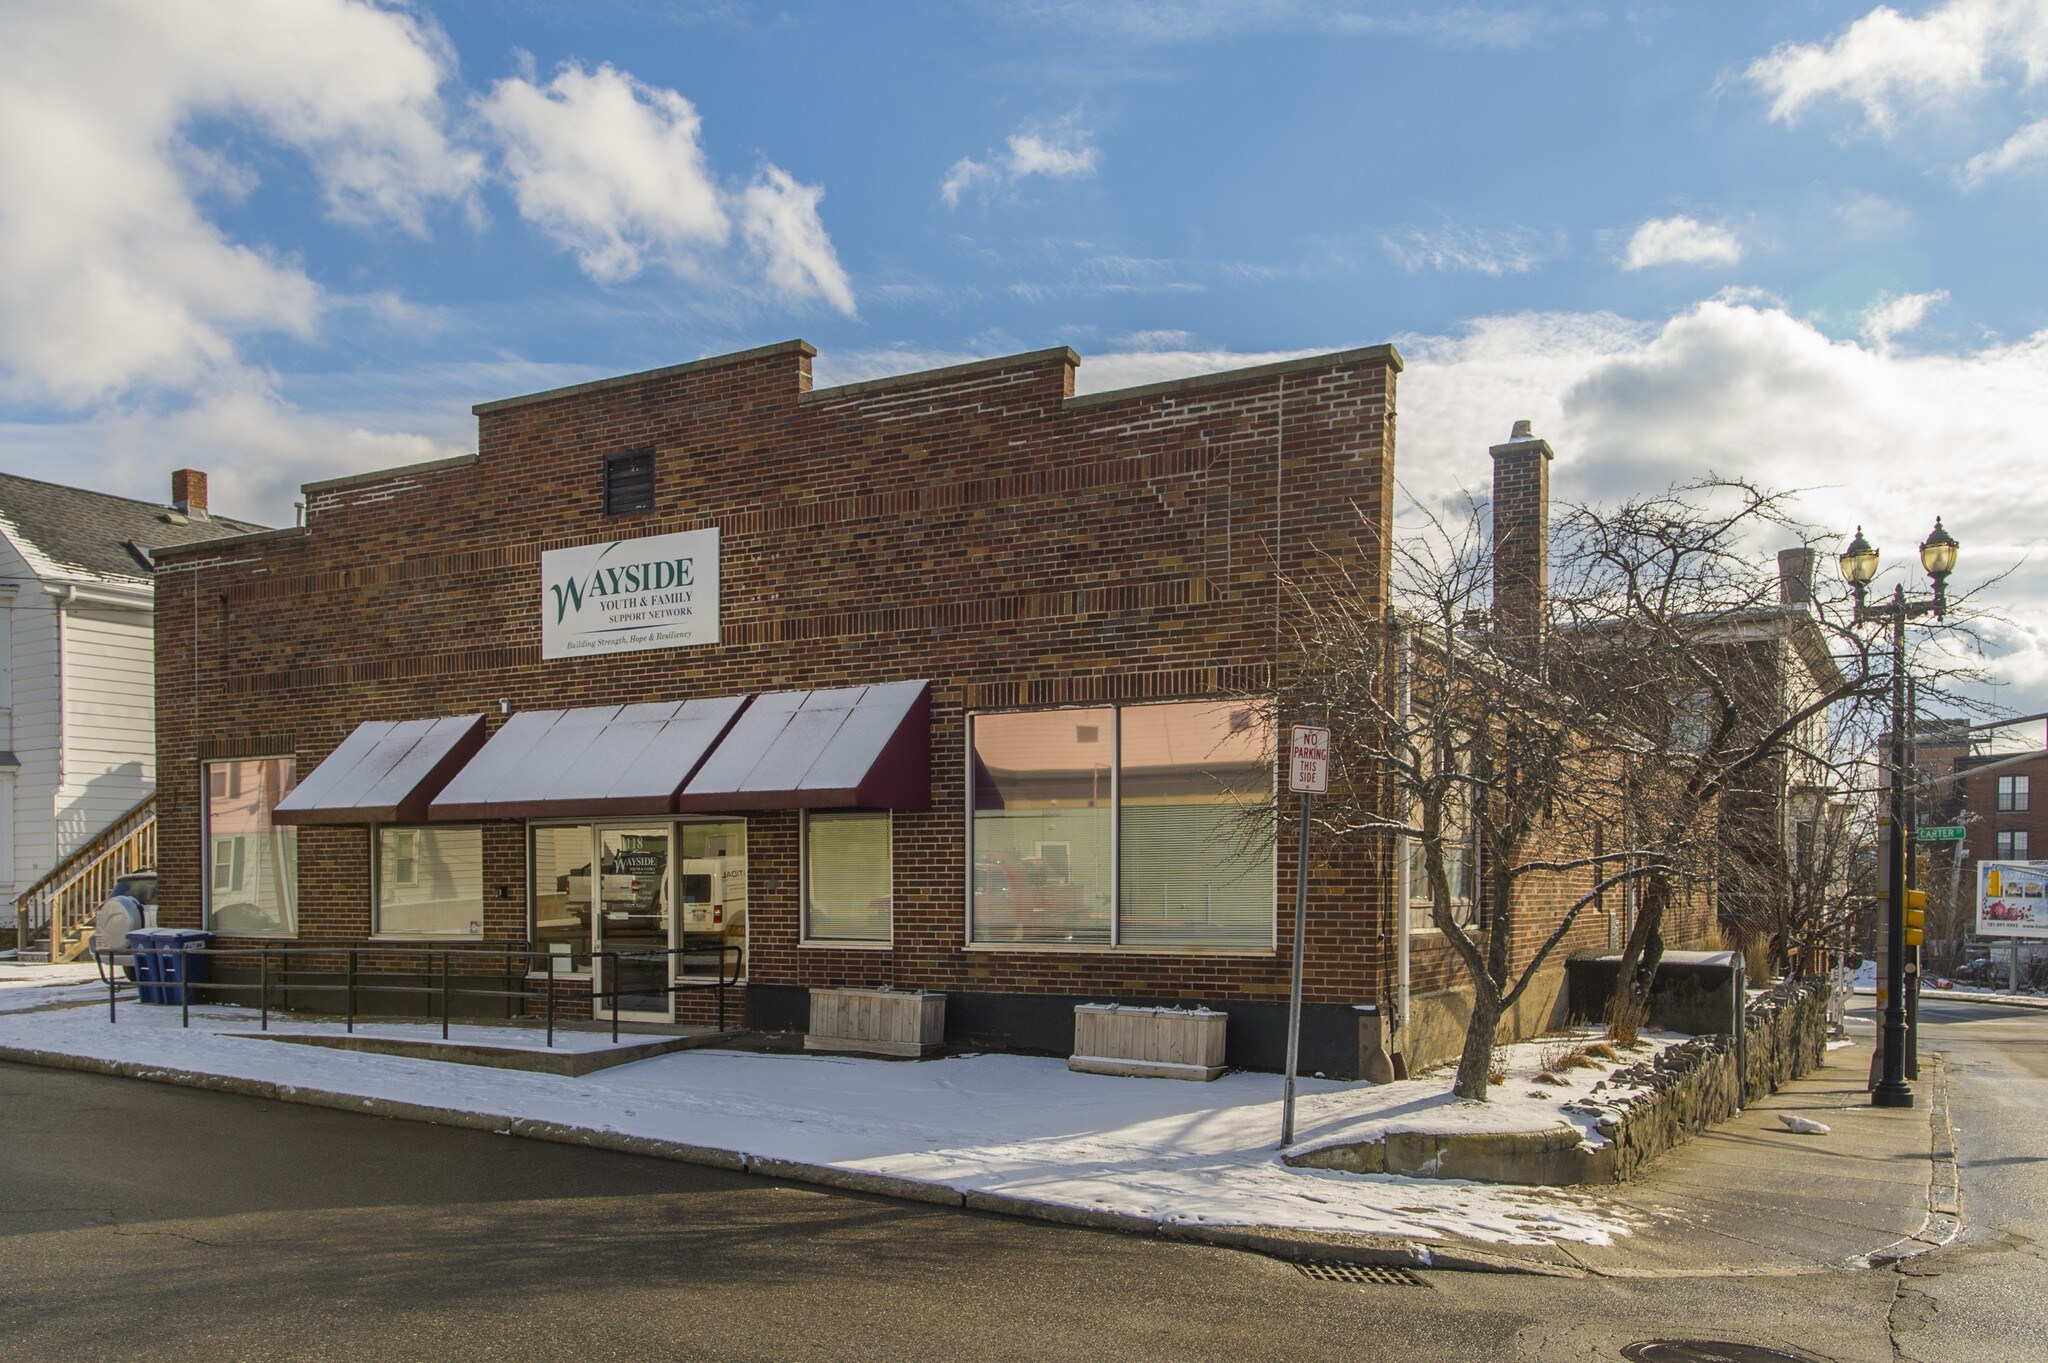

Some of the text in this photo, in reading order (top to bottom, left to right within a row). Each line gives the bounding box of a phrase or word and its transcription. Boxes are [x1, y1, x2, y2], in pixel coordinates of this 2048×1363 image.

[550, 546, 694, 625] WAYSIDE
[600, 591, 693, 611] YOUTH & FAMILY
[609, 607, 693, 624] SUPPORT NETWORK
[567, 631, 692, 649] Building Strength, Hope & Resiliency
[1304, 733, 1318, 745] NO
[1294, 746, 1327, 760] PARKING
[1300, 760, 1316, 772] THIS
[1300, 772, 1316, 783] SIDE
[1920, 829, 1954, 838] CARTER
[615, 854, 656, 873] WAYSIDE
